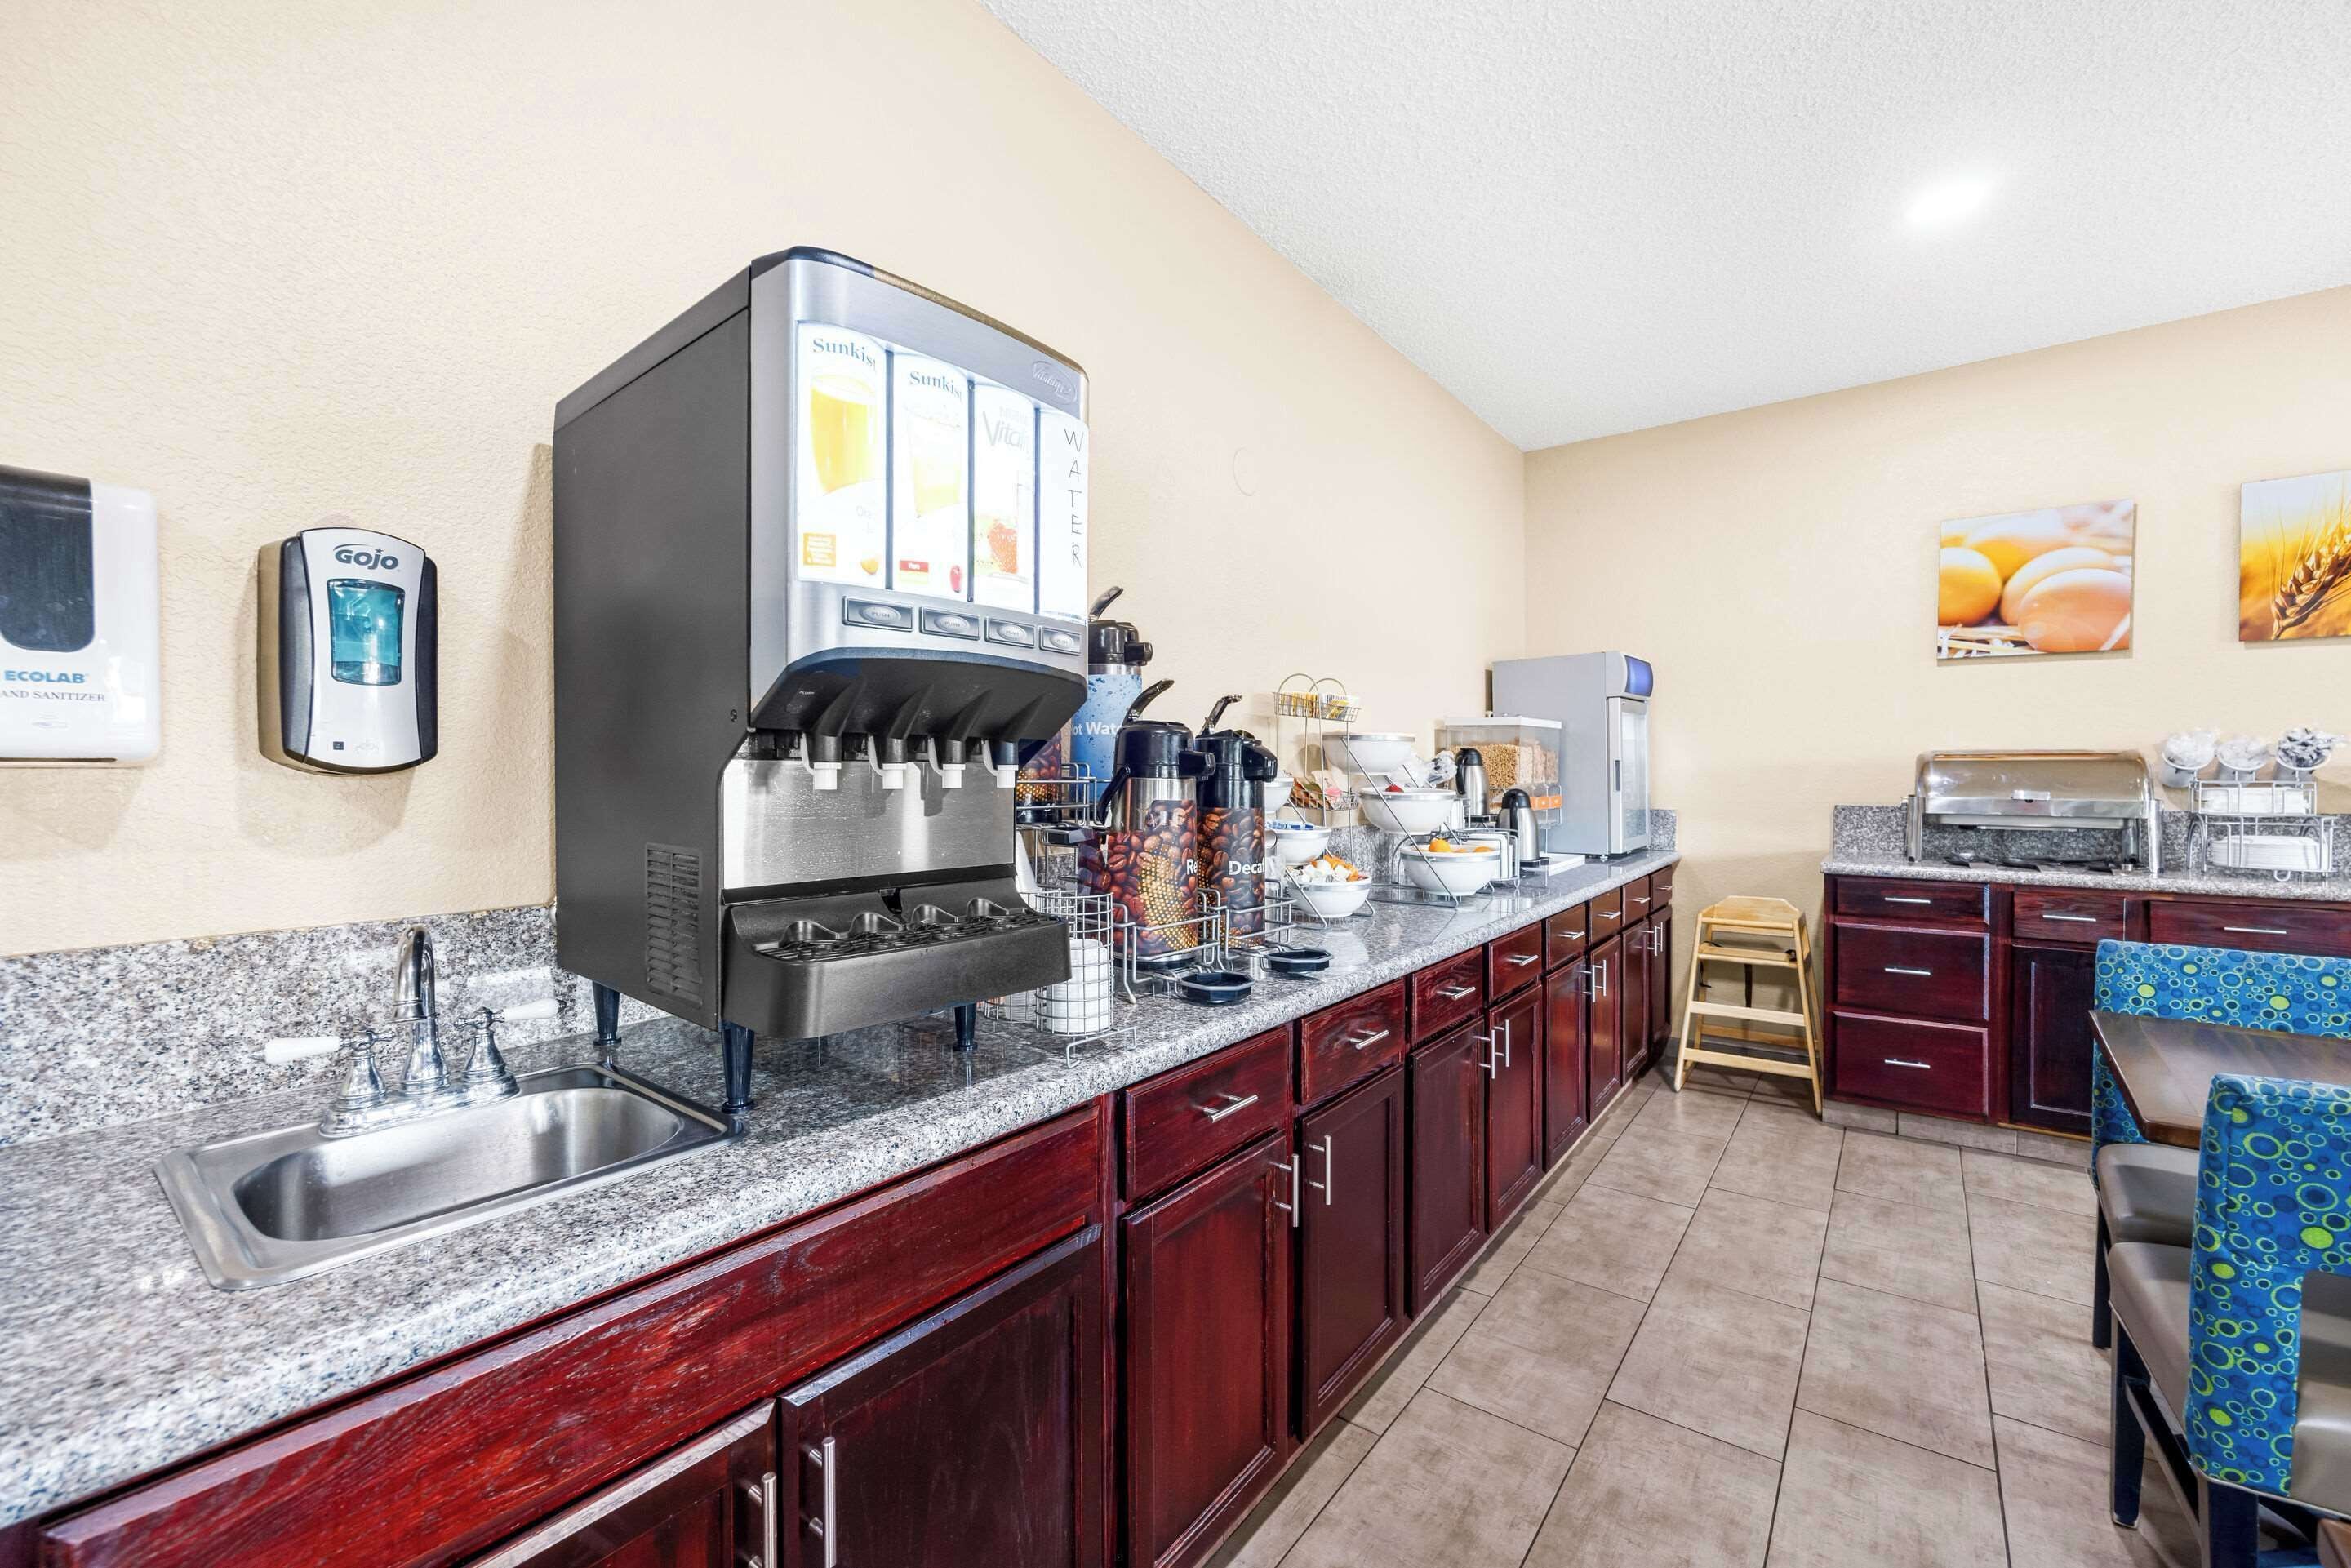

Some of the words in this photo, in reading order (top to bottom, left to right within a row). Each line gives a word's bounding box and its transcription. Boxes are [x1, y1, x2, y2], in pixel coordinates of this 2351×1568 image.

[1064, 429, 1084, 569] WATER
[4, 670, 86, 684] ECOLAB
[0, 690, 29, 699] AND
[33, 691, 105, 702] SANITIZER
[1071, 723, 1083, 736] ot
